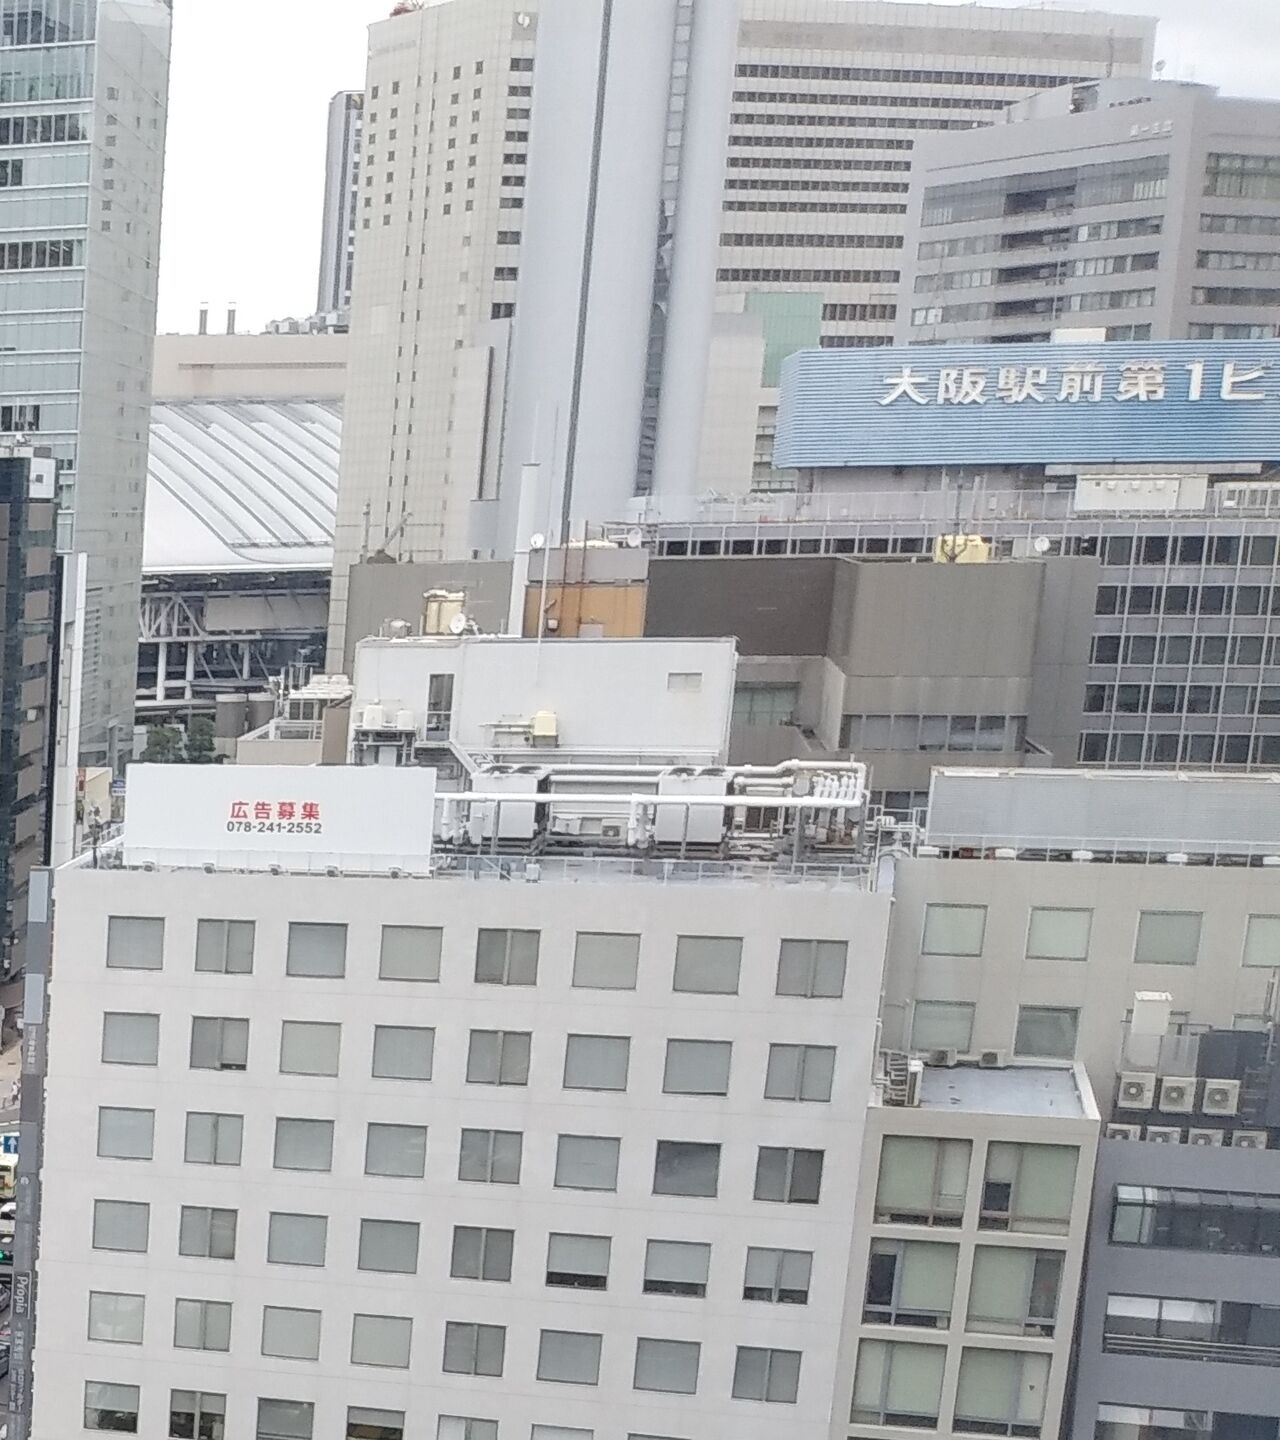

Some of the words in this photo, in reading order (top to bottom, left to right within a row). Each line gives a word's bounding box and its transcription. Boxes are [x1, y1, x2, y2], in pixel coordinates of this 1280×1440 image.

[230, 801, 320, 820] 広告募集
[227, 821, 322, 834] 078-241-2552
